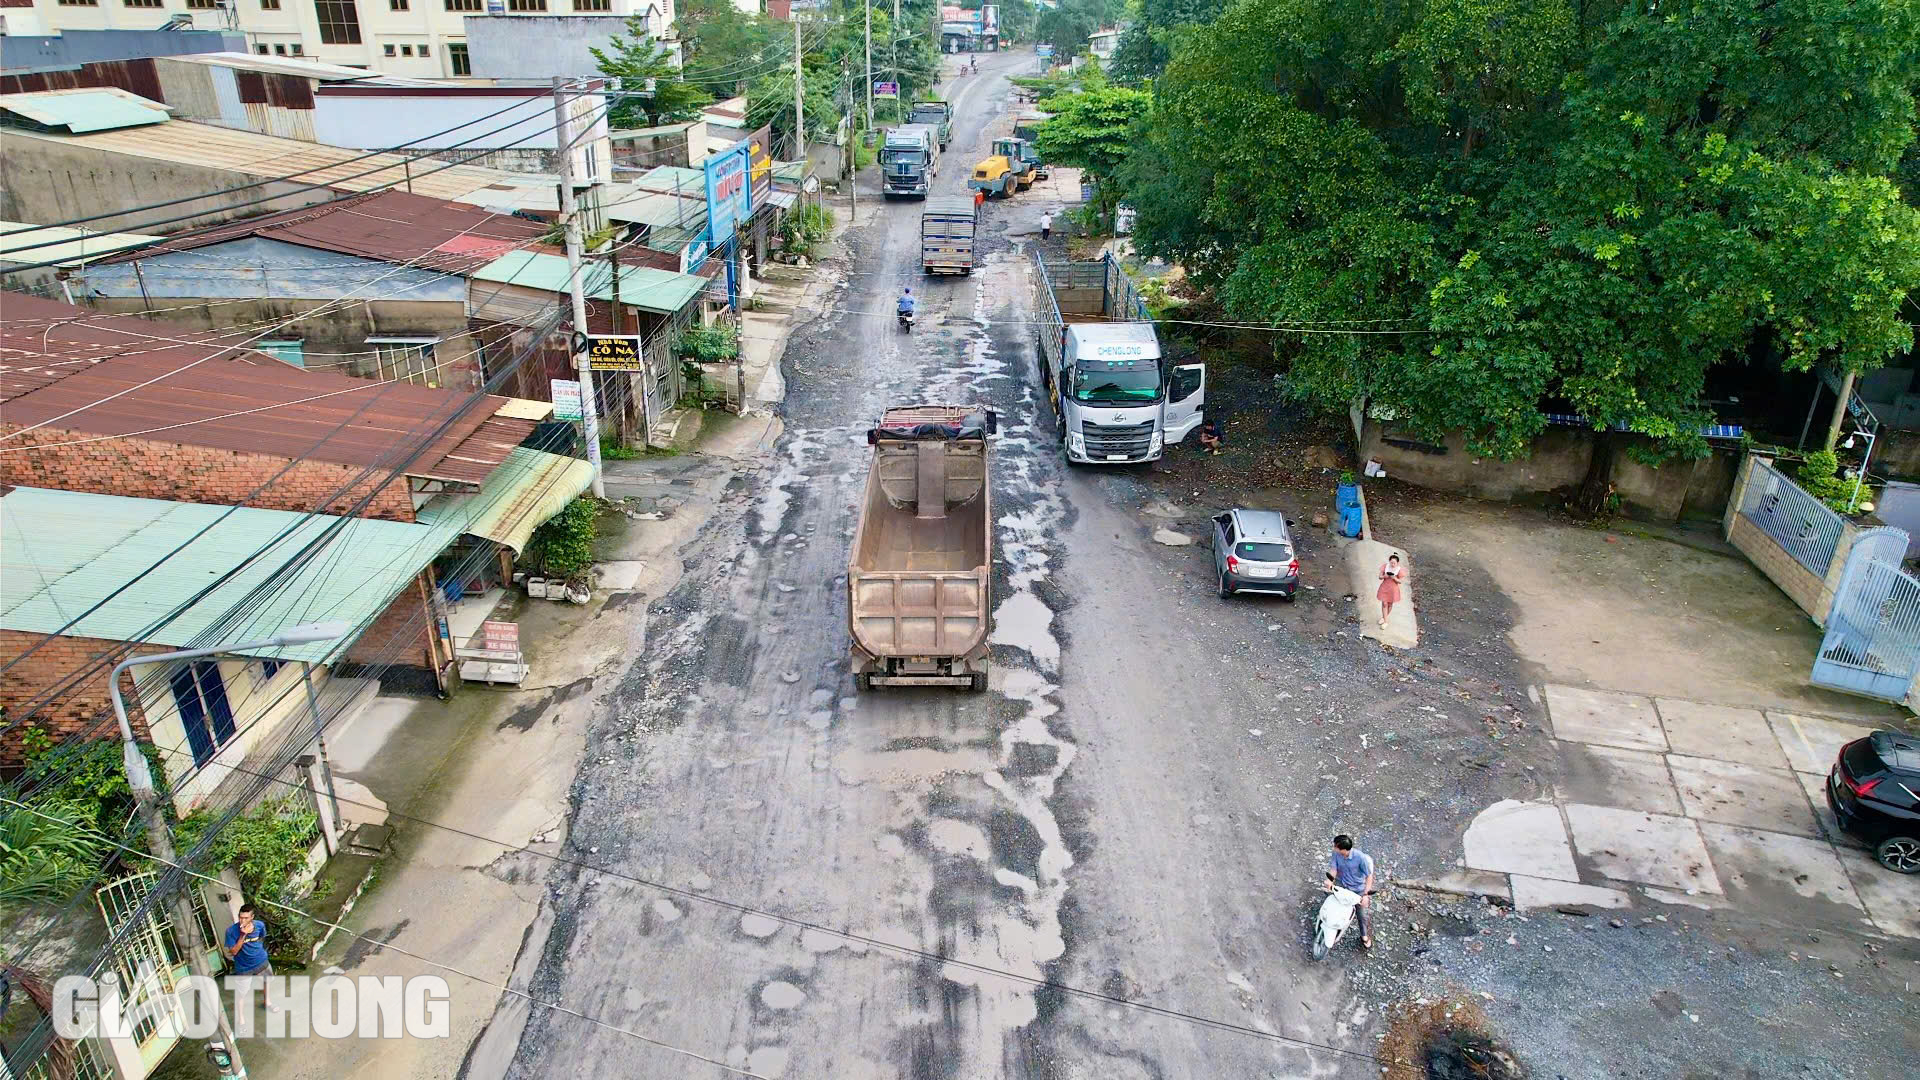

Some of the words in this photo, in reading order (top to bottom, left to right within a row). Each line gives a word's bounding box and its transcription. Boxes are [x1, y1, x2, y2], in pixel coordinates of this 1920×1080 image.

[593, 345, 611, 354] CÔ
[616, 346, 634, 354] NA
[1097, 346, 1141, 355] CHENGLONG
